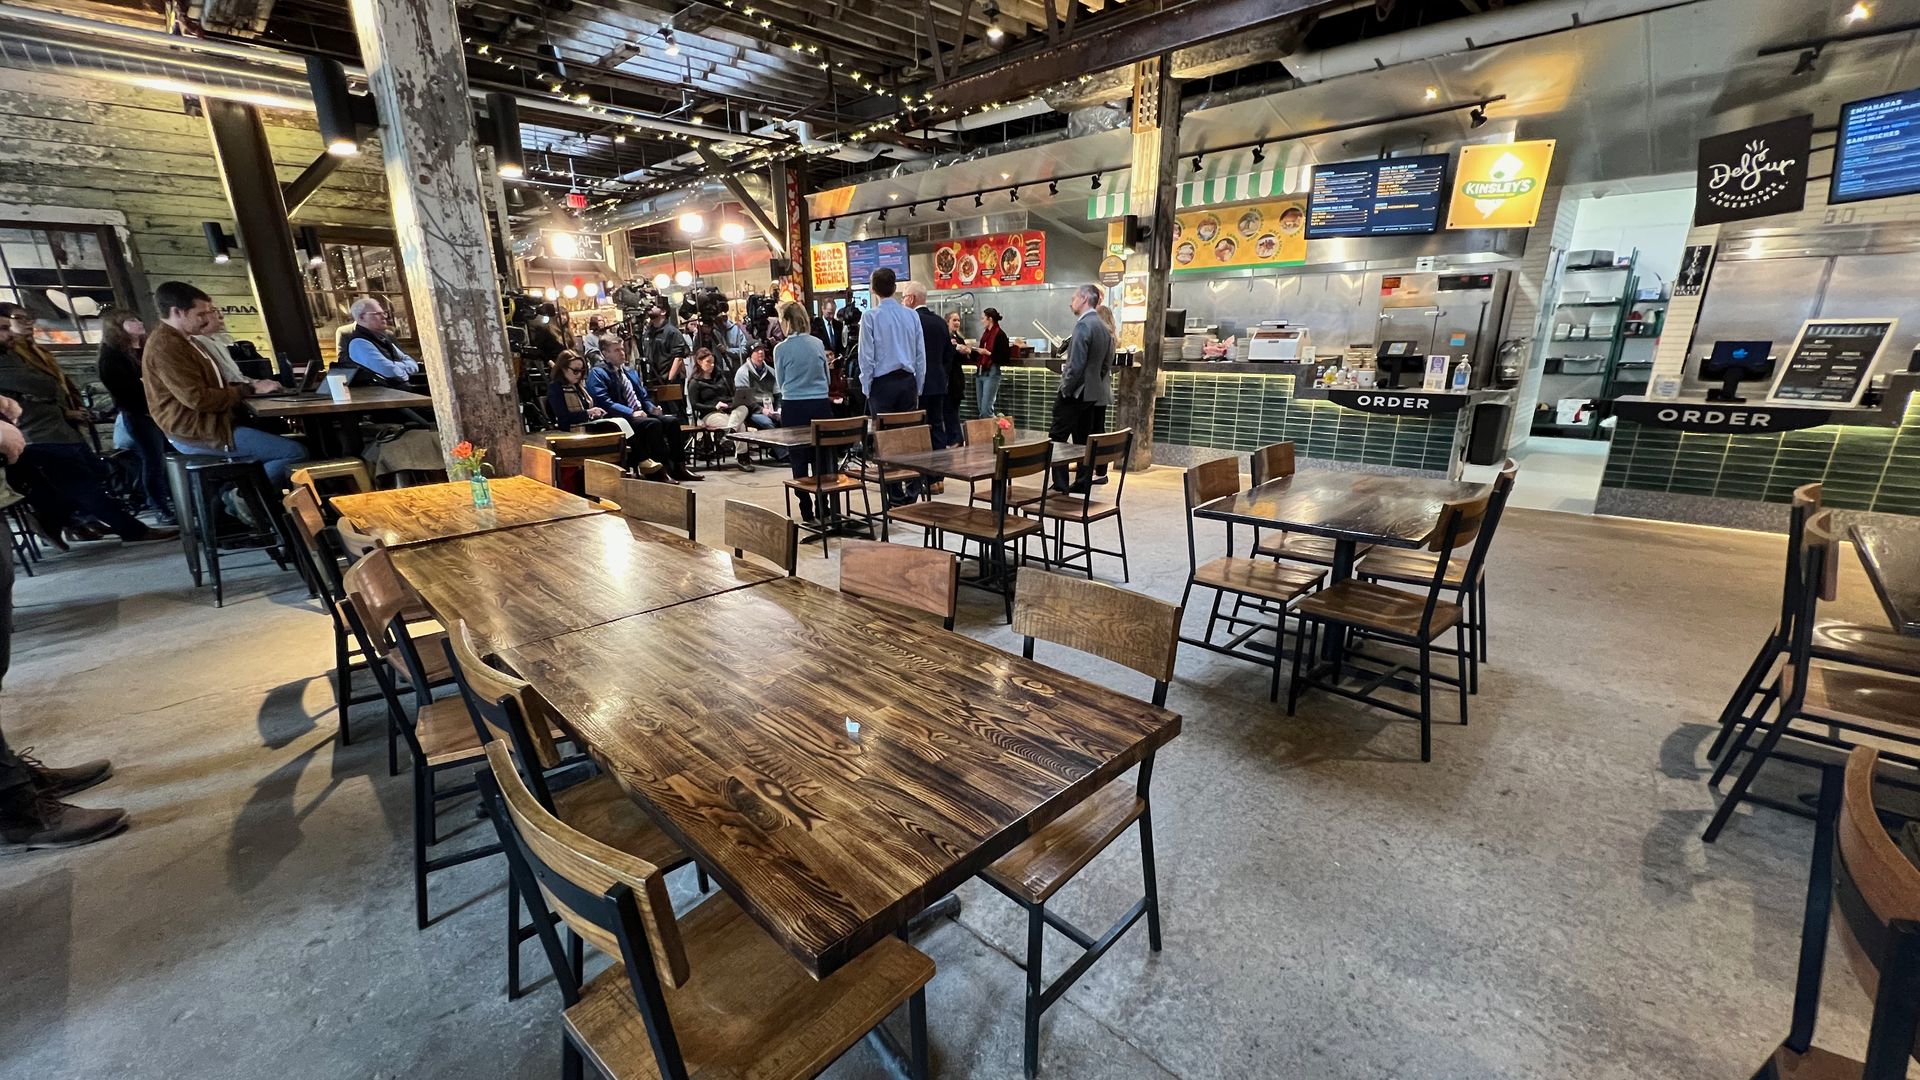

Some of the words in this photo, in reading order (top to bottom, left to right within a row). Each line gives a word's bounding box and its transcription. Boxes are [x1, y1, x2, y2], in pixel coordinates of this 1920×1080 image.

[1850, 99, 1903, 115] EMPANADAS
[1846, 129, 1901, 145] SANDWICHES
[1465, 178, 1532, 195] KINSLEY'S
[1718, 182, 1777, 201] EMPANADAS
[1709, 184, 1787, 209] ARGENTINAS
[813, 247, 844, 262] WORLD
[815, 271, 846, 285] KITCHEN
[1357, 395, 1430, 409] ORDER
[1657, 408, 1772, 427] ORDER
